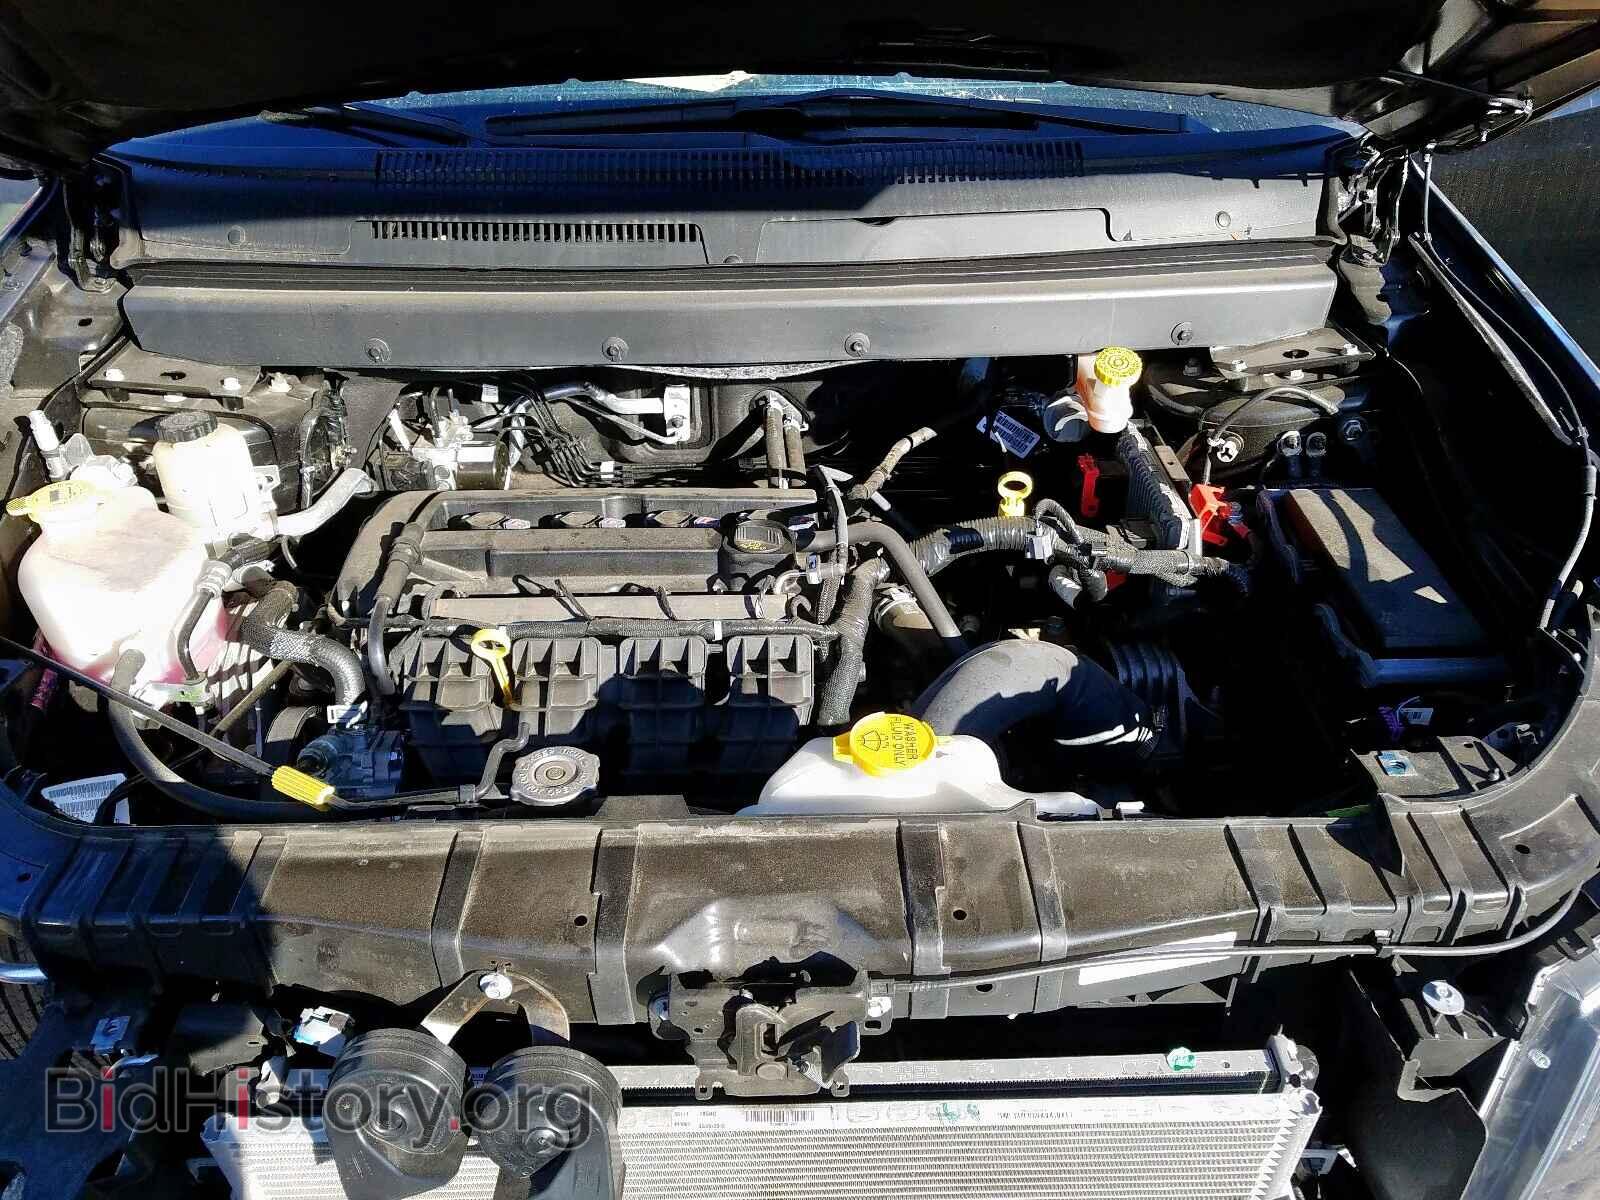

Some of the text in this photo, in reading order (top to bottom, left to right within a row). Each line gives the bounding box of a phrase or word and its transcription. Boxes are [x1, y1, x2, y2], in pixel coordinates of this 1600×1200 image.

[889, 716, 907, 767] FLUID ONLY
[903, 722, 919, 760] WASHER
